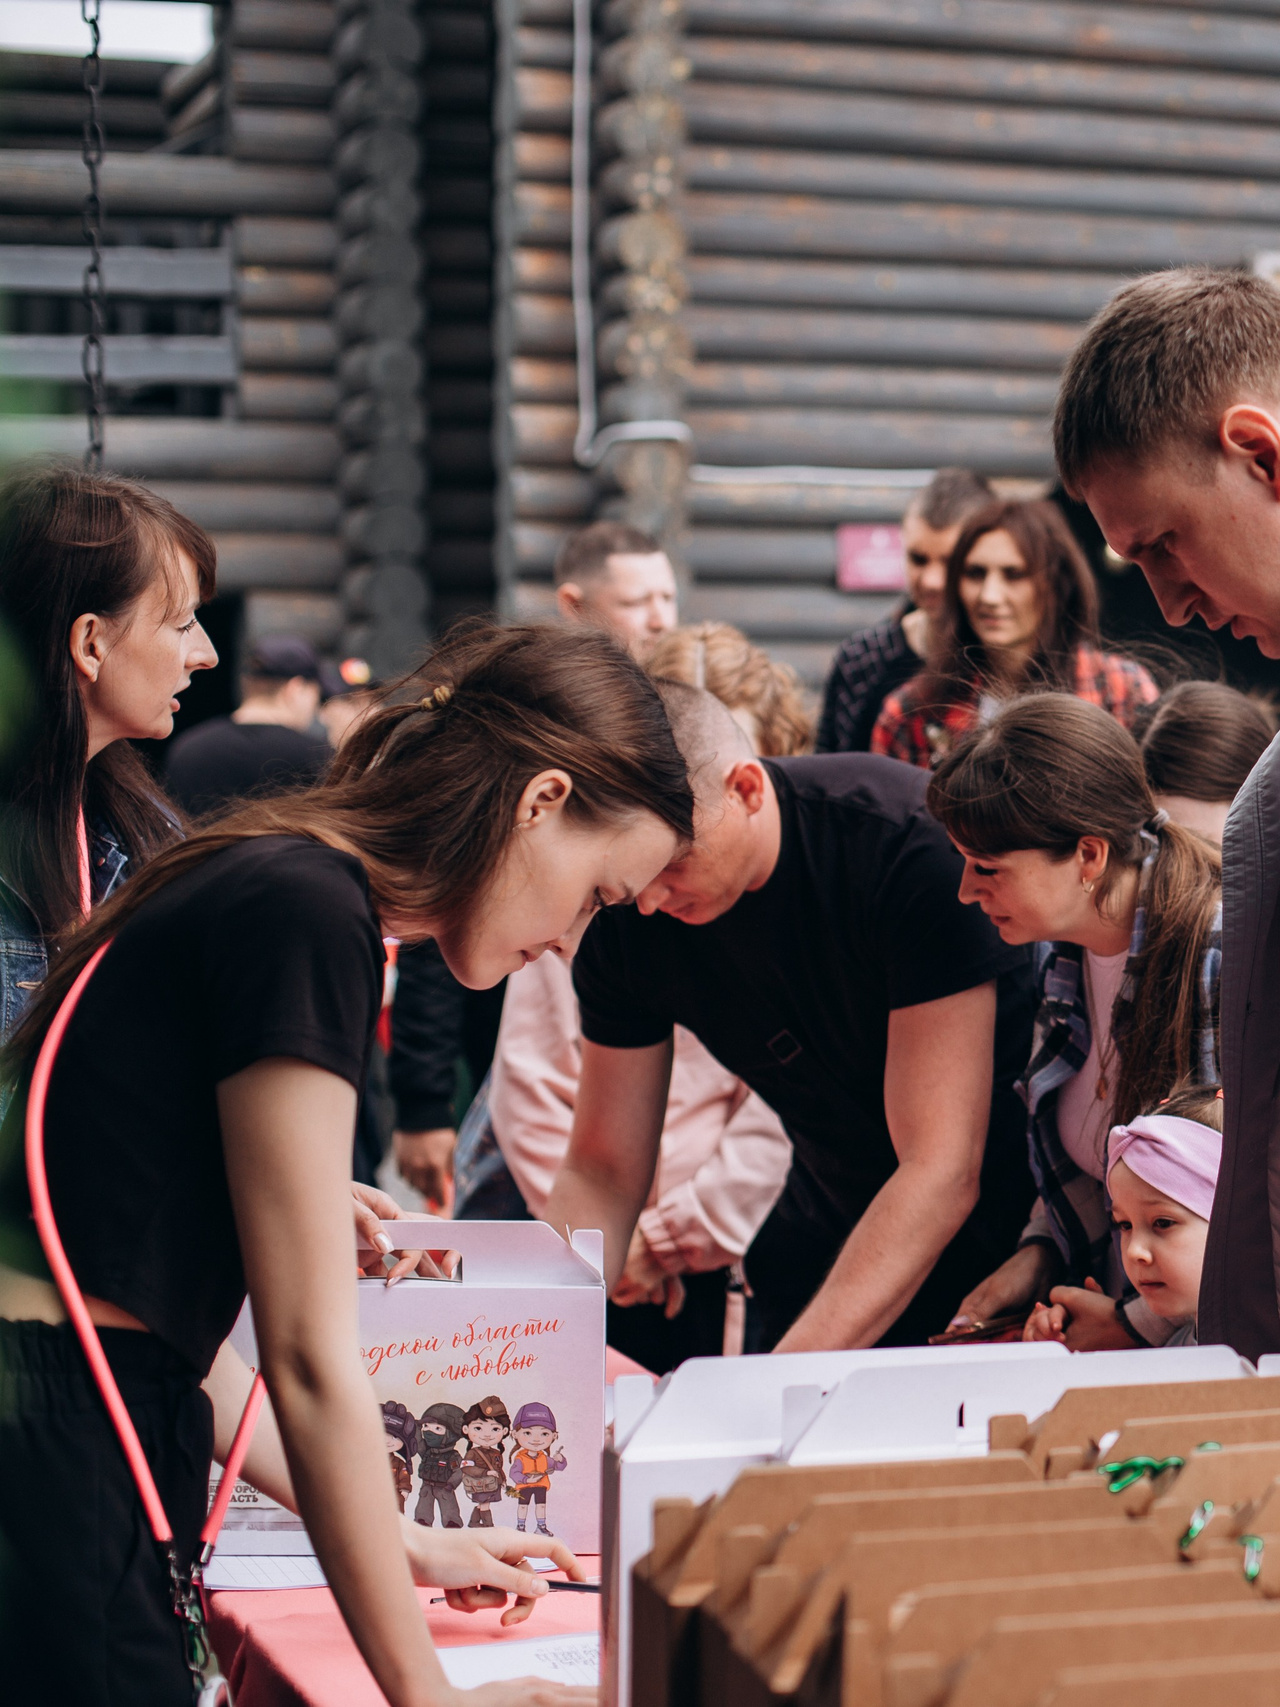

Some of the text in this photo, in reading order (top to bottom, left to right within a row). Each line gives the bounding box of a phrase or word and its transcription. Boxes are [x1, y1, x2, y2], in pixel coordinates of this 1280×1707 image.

[360, 1315, 565, 1376] одской области
[415, 1341, 539, 1385] с любовью
